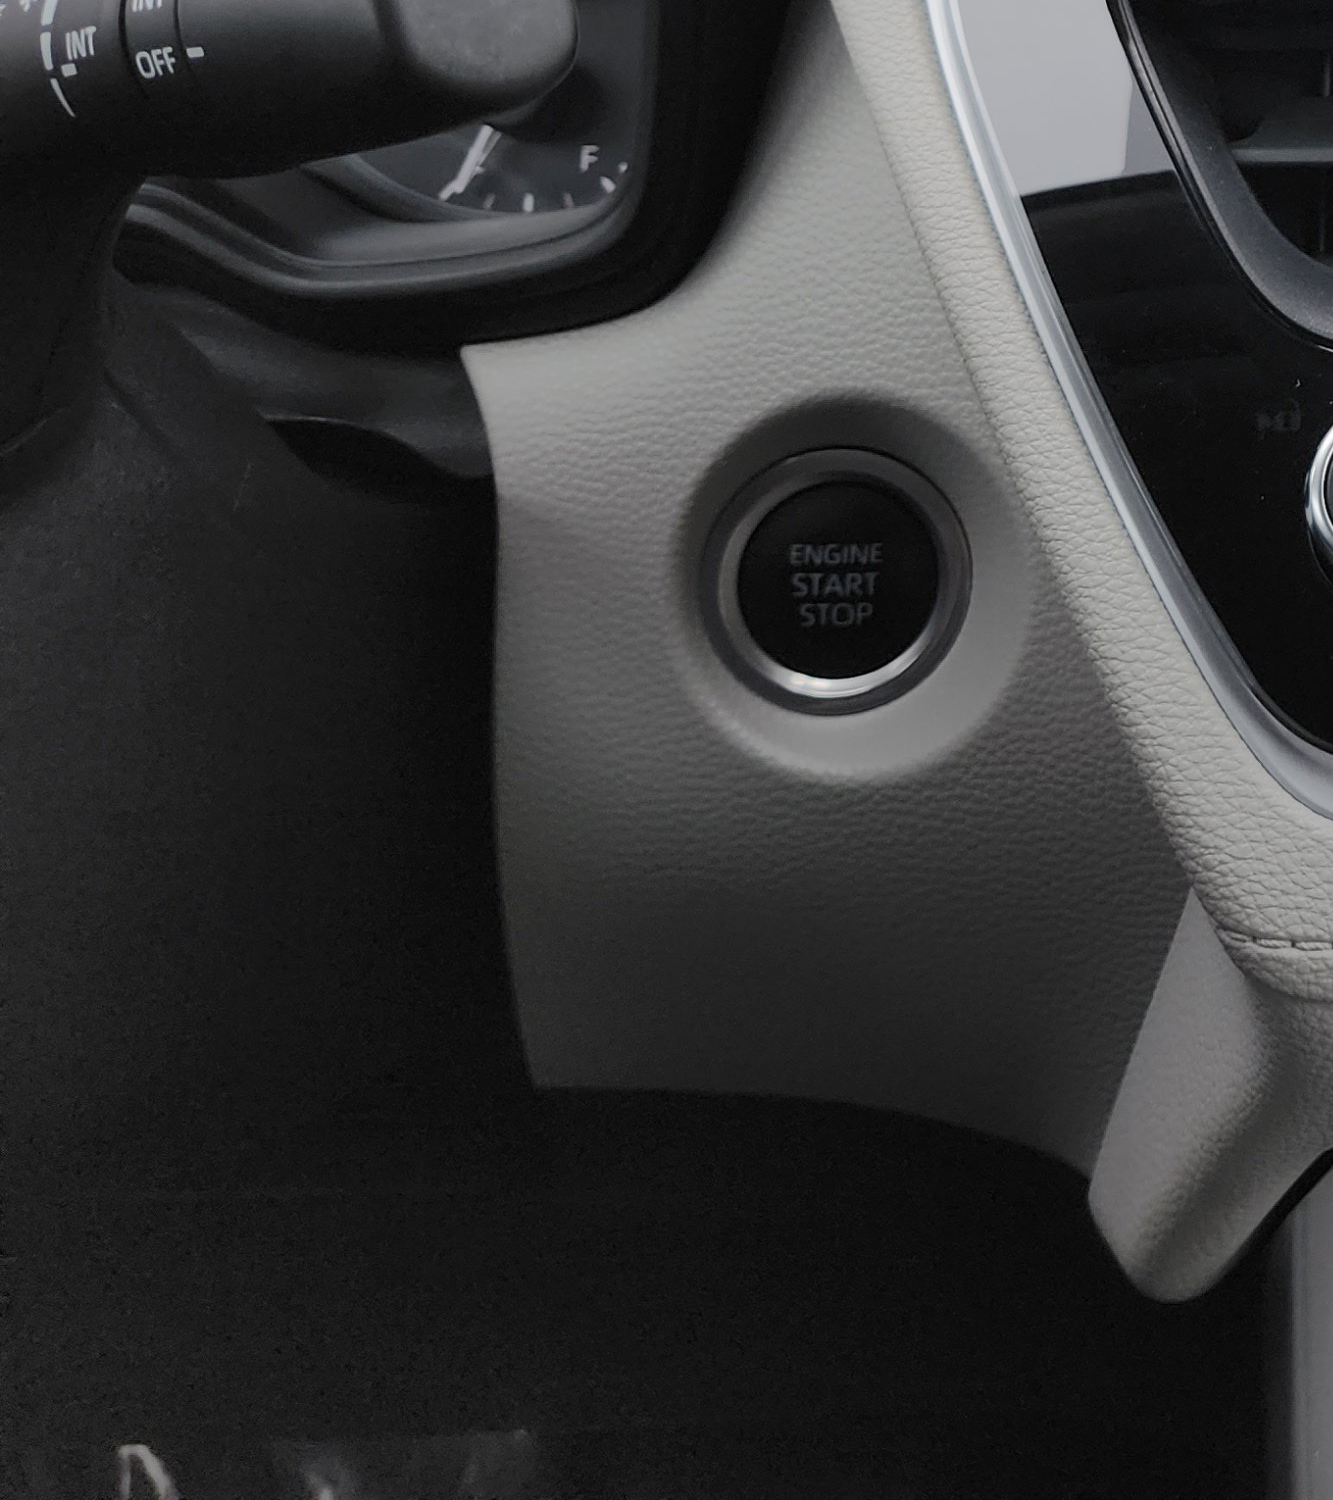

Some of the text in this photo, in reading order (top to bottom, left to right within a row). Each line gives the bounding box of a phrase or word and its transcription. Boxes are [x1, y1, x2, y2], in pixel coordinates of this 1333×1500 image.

[65, 25, 97, 61] INT
[135, 47, 176, 79] OFF
[579, 144, 600, 172] F
[789, 543, 883, 565] ENGINE
[790, 572, 880, 597] START
[800, 602, 874, 628] STOP
